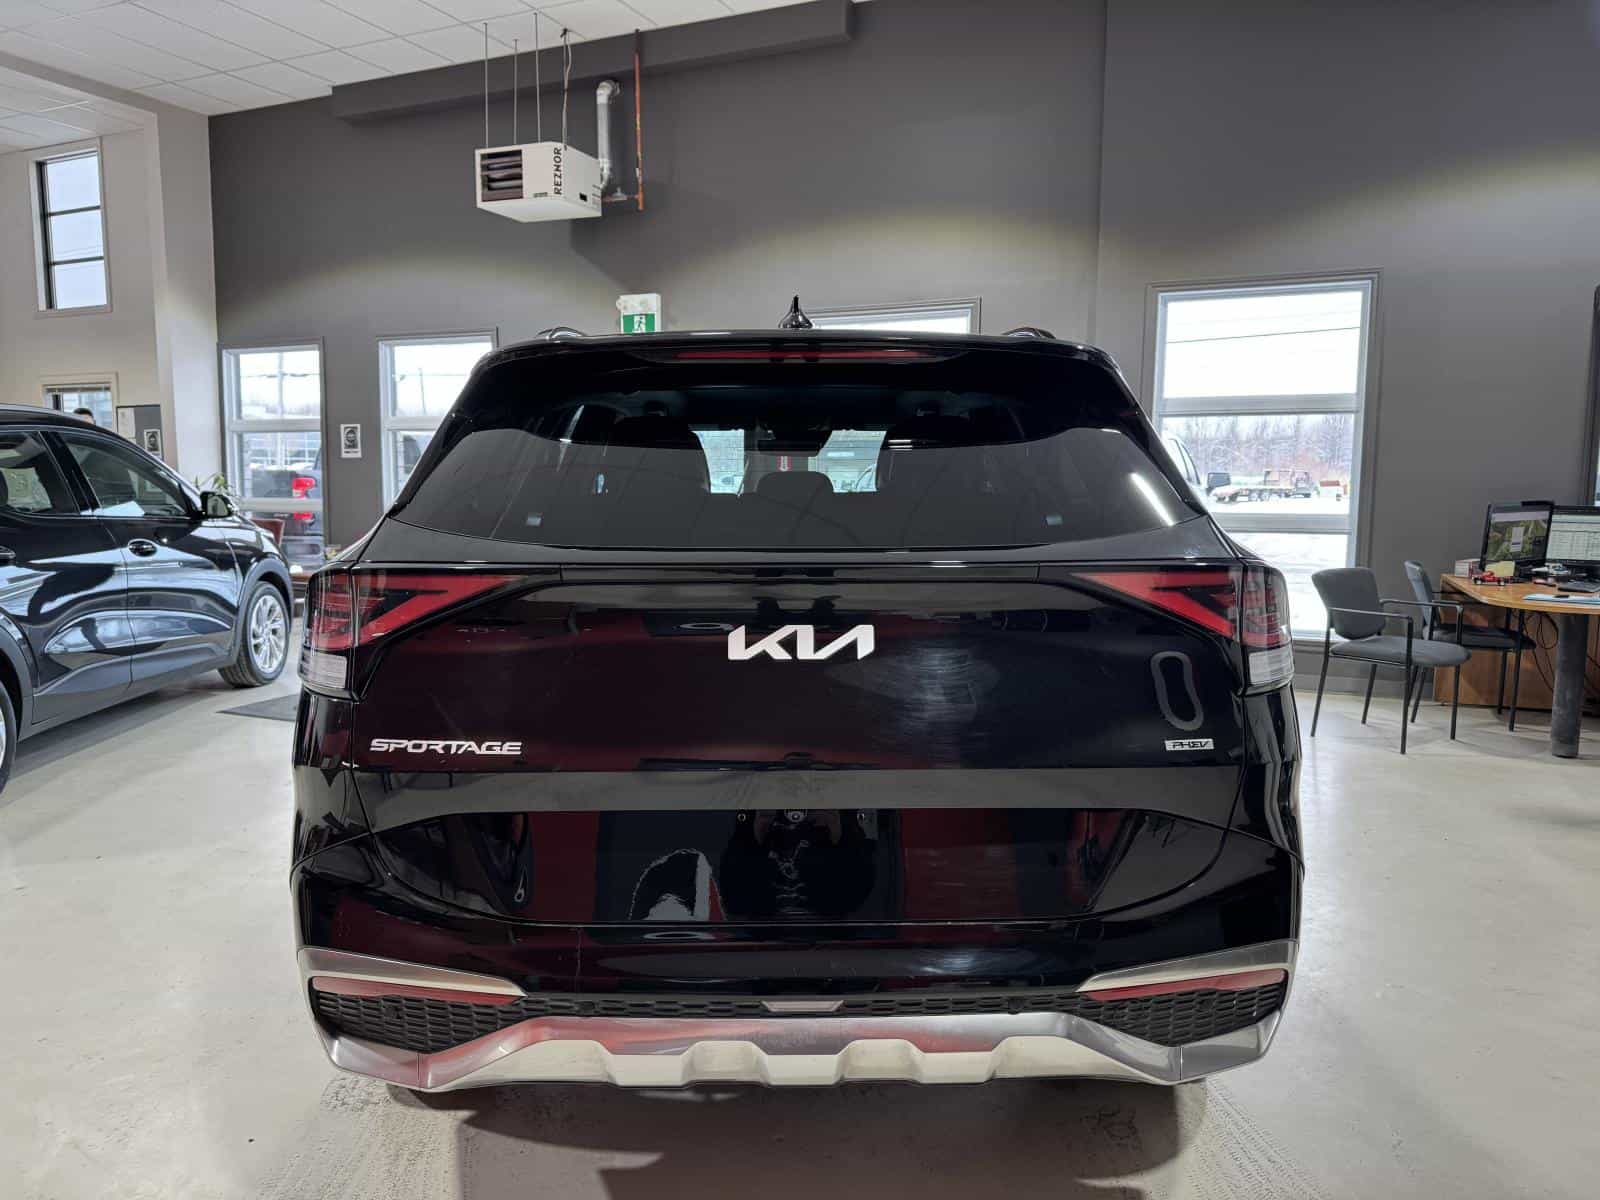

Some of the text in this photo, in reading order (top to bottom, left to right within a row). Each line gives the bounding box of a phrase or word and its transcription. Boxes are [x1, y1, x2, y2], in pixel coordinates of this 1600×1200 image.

[553, 147, 563, 196] REZNOR
[727, 624, 875, 661] KIA
[369, 738, 523, 755] SPORTAGE
[1169, 740, 1211, 750] PHEV
